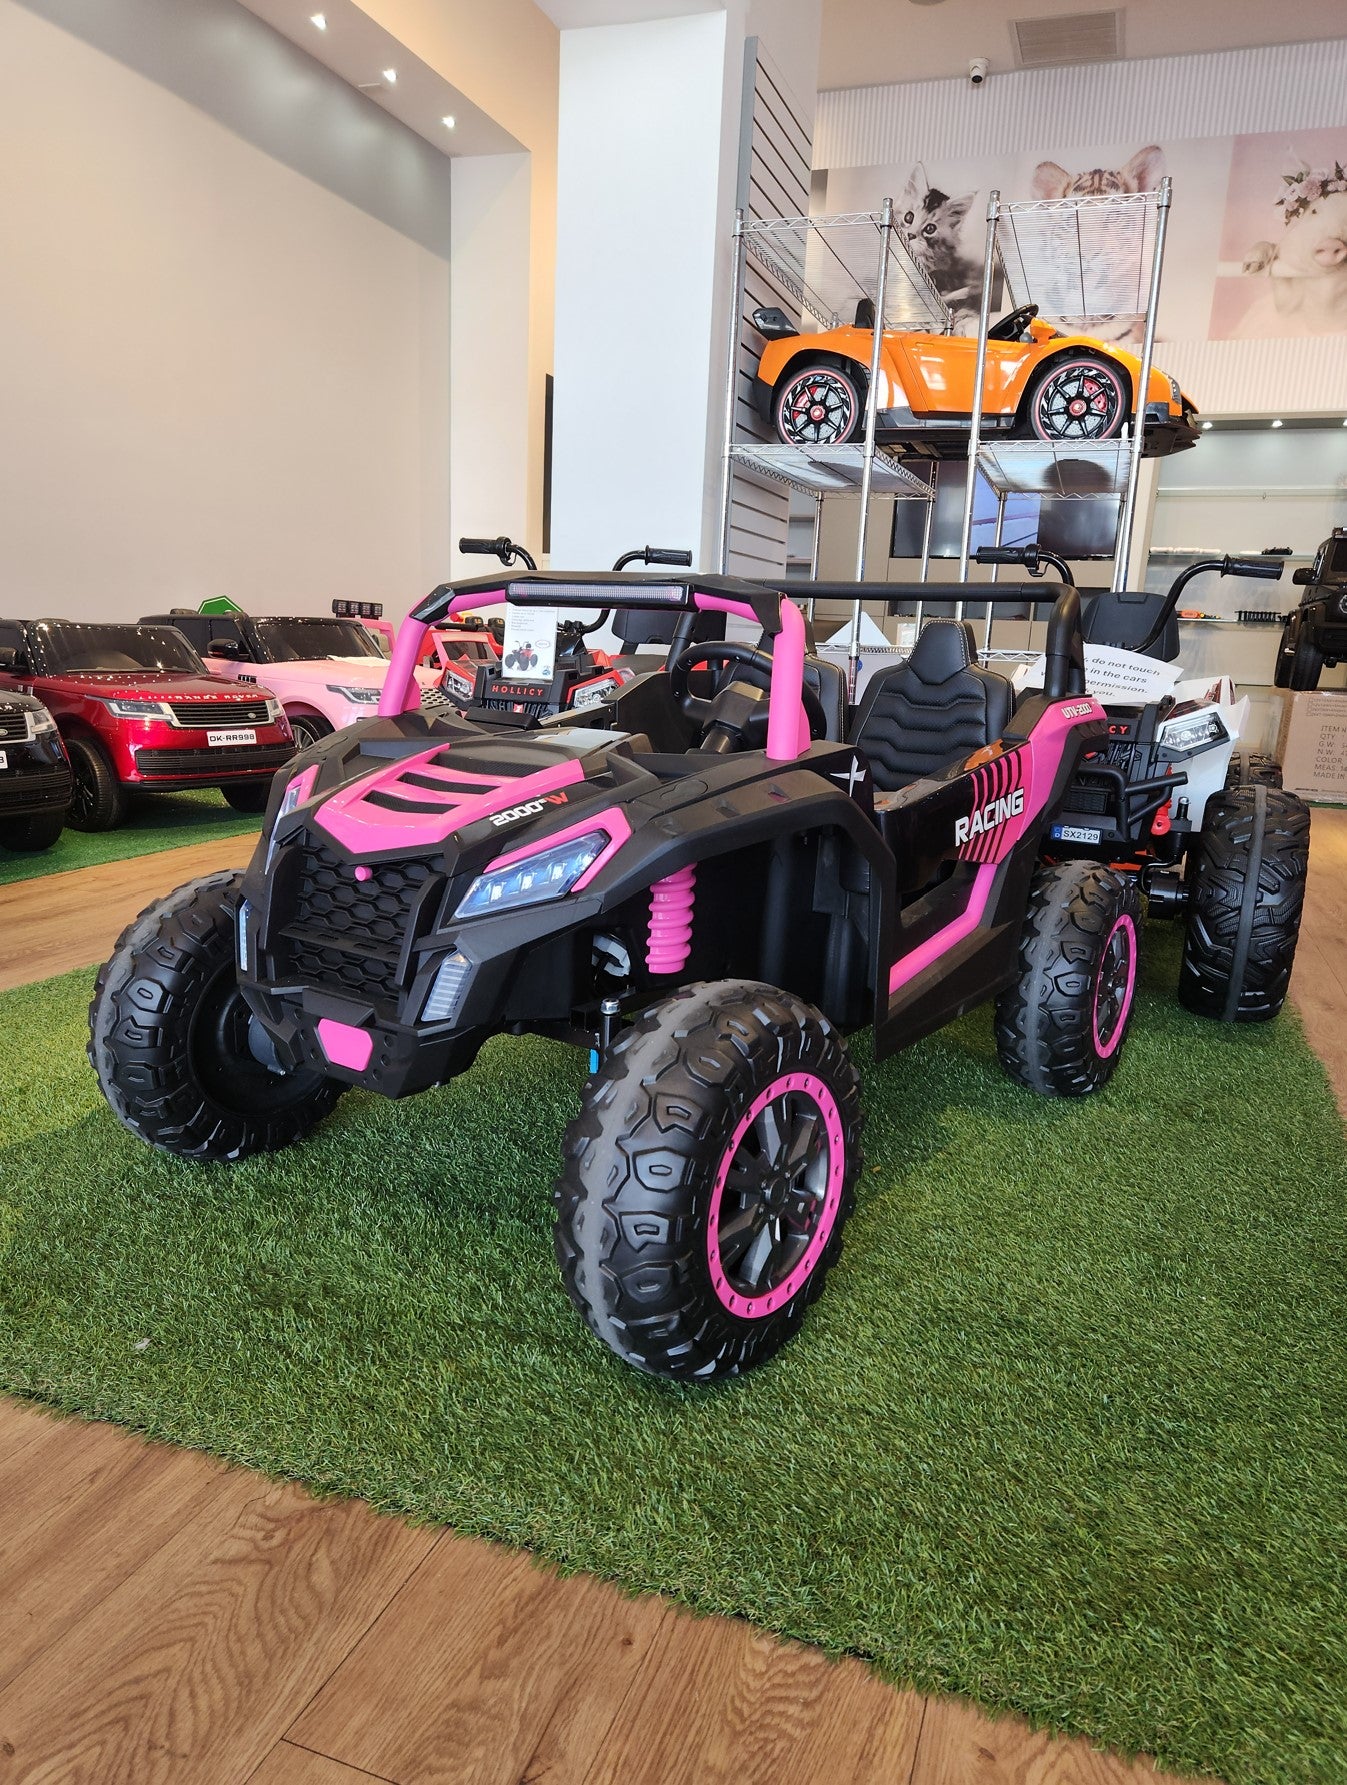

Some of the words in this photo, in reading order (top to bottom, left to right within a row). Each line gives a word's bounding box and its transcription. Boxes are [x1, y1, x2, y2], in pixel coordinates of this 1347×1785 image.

[1092, 657, 1106, 665] do
[1107, 661, 1126, 669] not
[1129, 663, 1161, 676] touch
[1090, 667, 1101, 675] in
[1103, 670, 1121, 679] the
[1123, 674, 1148, 683] cars
[491, 684, 544, 696] HOLLICY
[1320, 725, 1340, 733] ITEM
[1313, 771, 1336, 779] MADE
[954, 788, 1025, 847] RACING
[1063, 829, 1099, 841] SX2129
